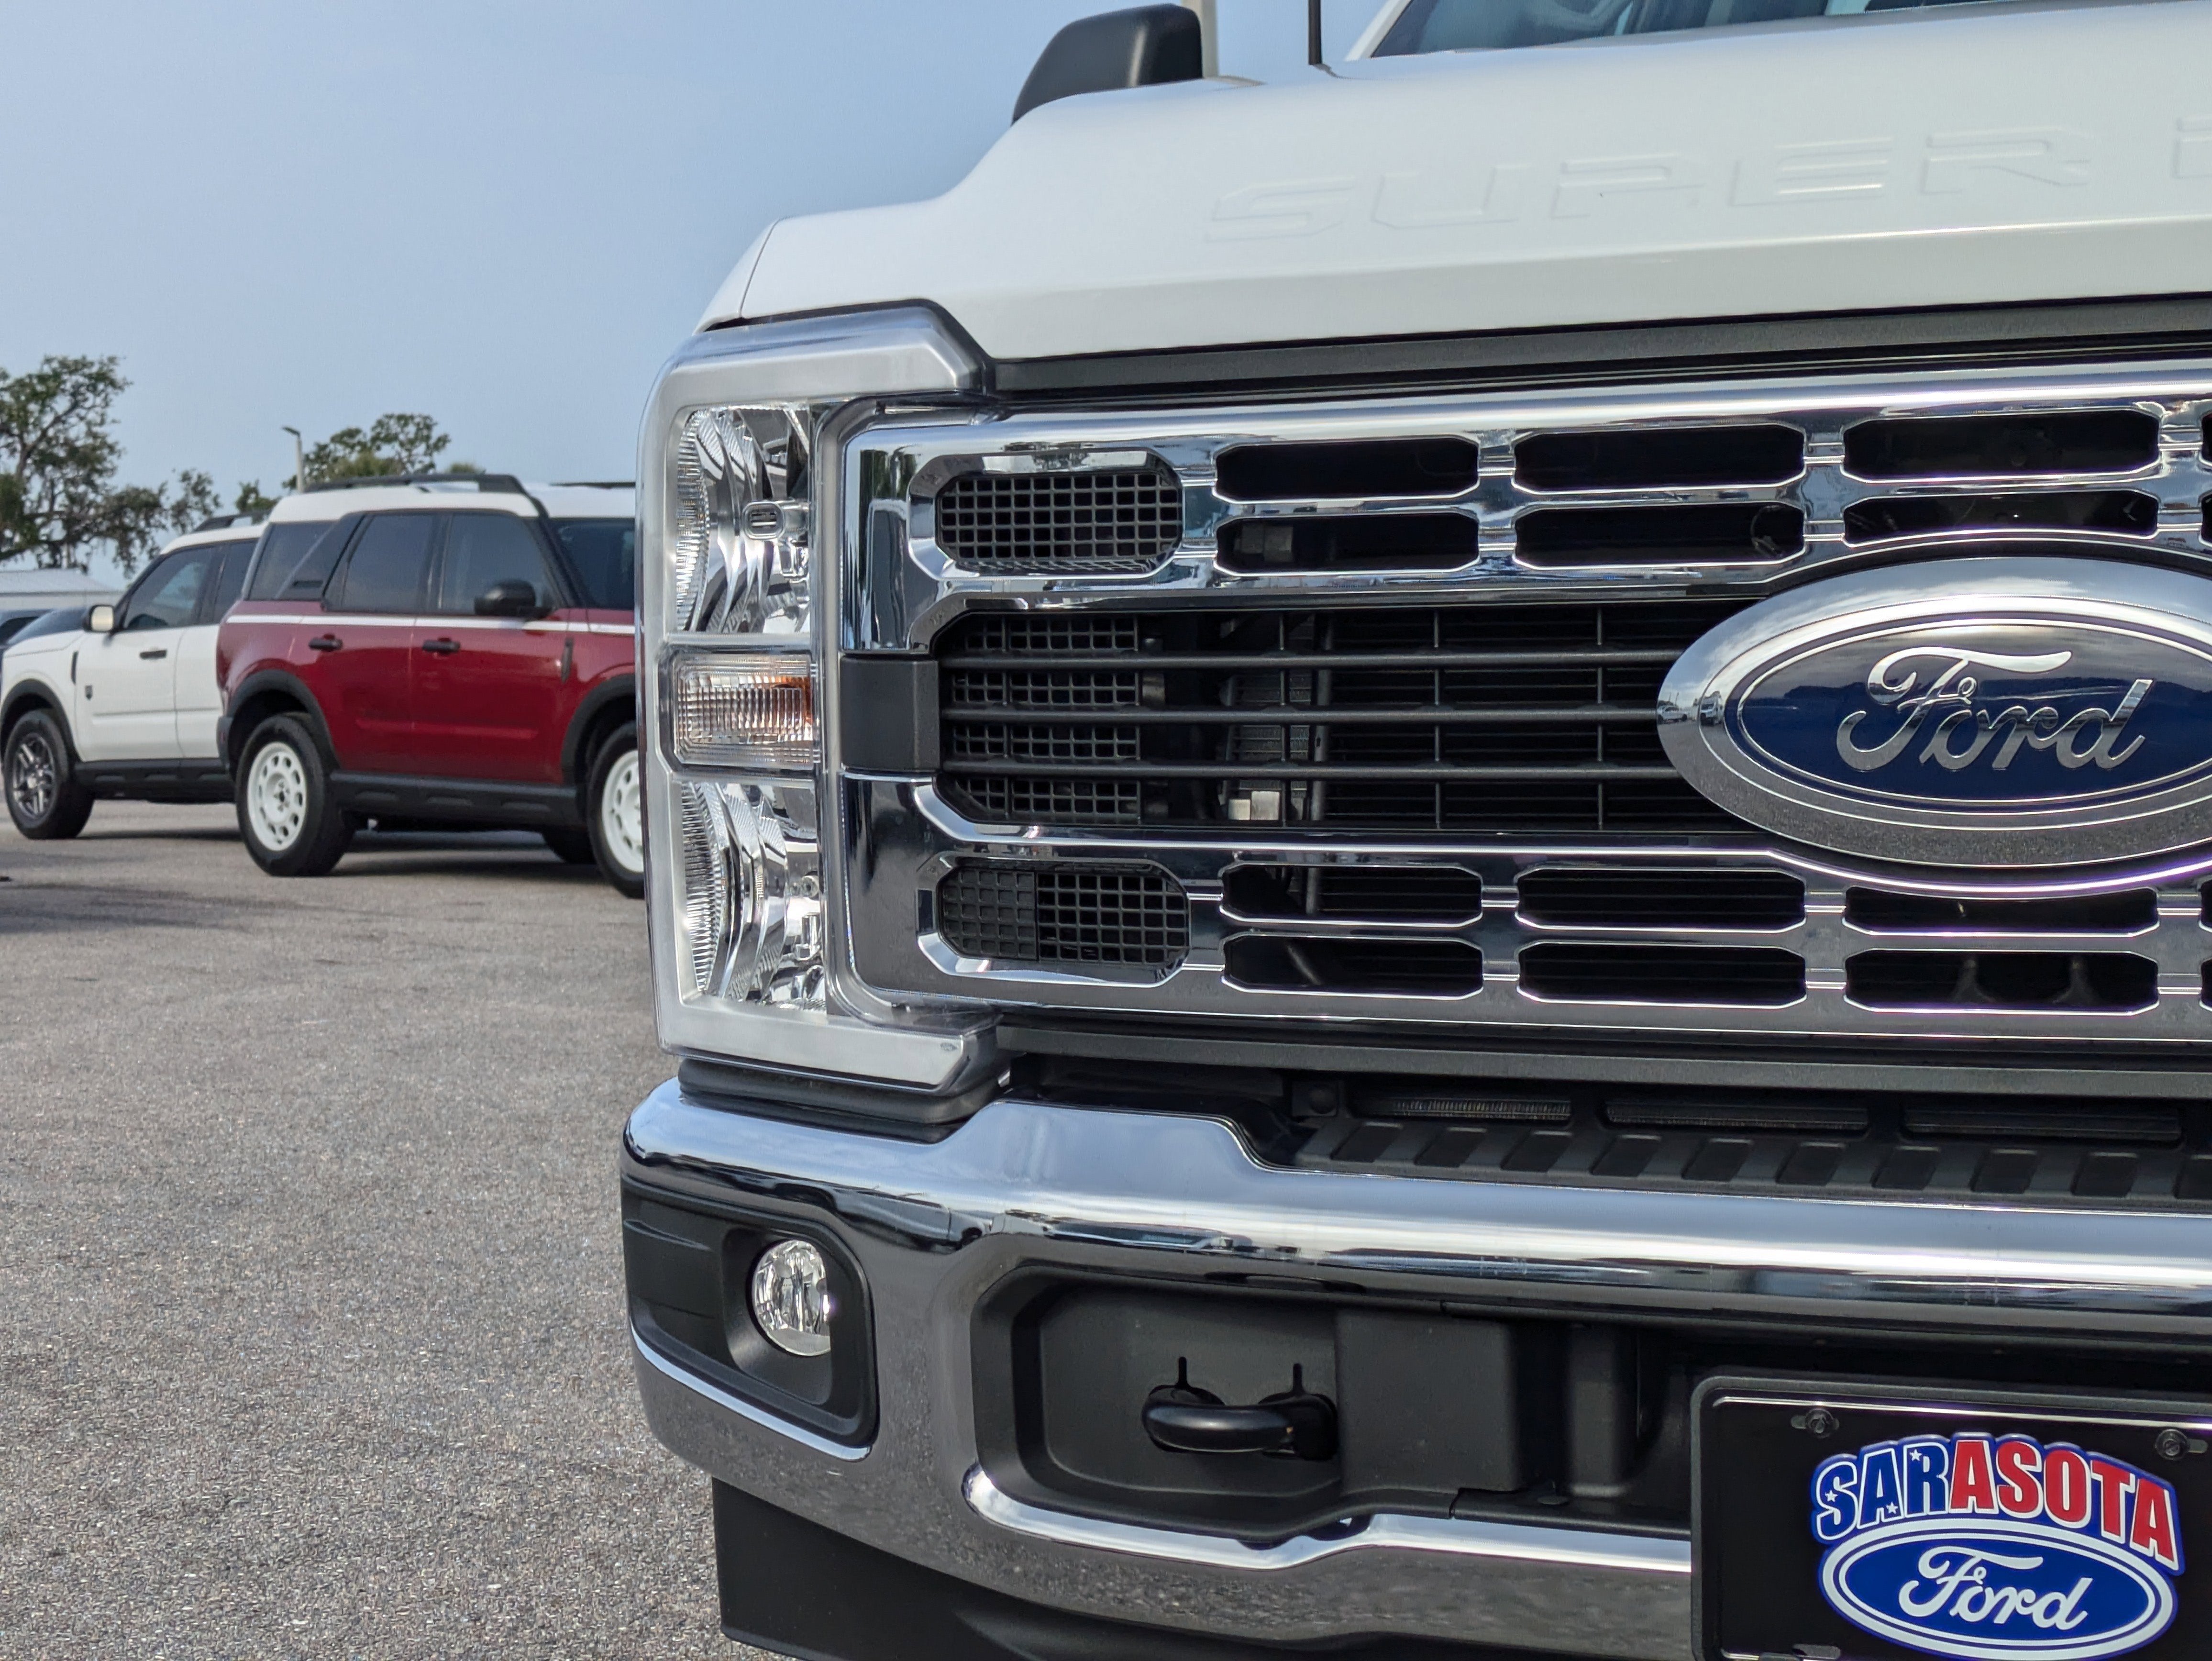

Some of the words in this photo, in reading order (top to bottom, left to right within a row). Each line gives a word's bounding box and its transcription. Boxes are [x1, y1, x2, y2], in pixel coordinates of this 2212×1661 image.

[1205, 125, 2091, 242] SUPER
[1836, 646, 2154, 771] Ford
[1815, 1438, 2180, 1571] SARASOTA
[1898, 1545, 2093, 1630] Ford
